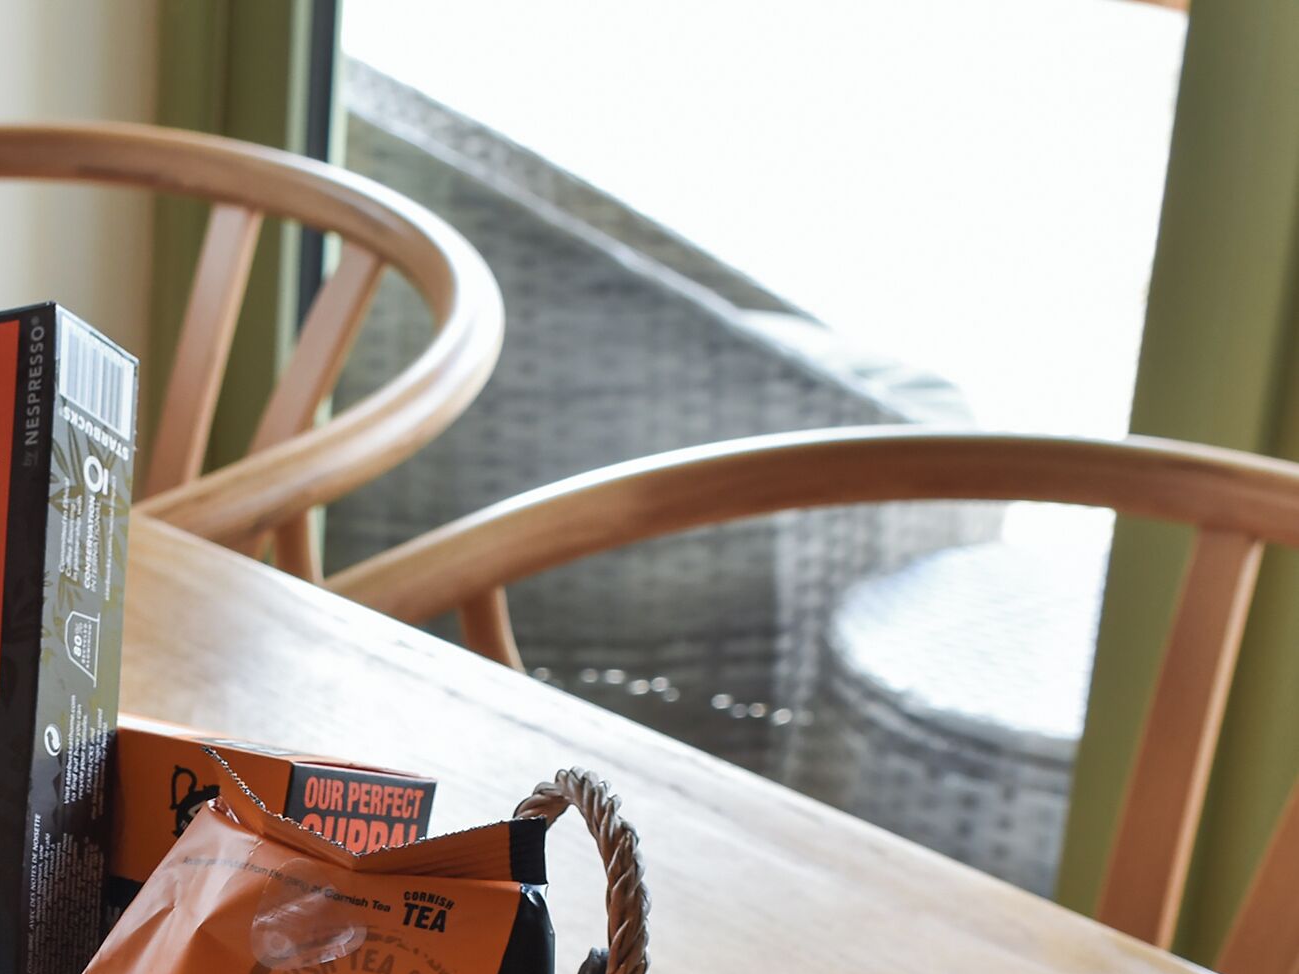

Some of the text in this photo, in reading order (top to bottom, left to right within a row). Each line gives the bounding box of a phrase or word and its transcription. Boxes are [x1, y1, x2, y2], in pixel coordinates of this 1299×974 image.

[84, 495, 96, 589] CONSERVATION
[91, 500, 101, 592] INTERNATIONAL
[73, 739, 81, 756] how
[87, 745, 95, 793] STARBUCKS
[304, 776, 425, 819] OUR PERFECT
[32, 813, 41, 851] NOISETTE
[31, 852, 38, 864] DE
[324, 888, 369, 908] Cornish
[372, 899, 392, 913] Tea
[402, 902, 448, 933] TEA
[403, 890, 456, 911] CORNISH
